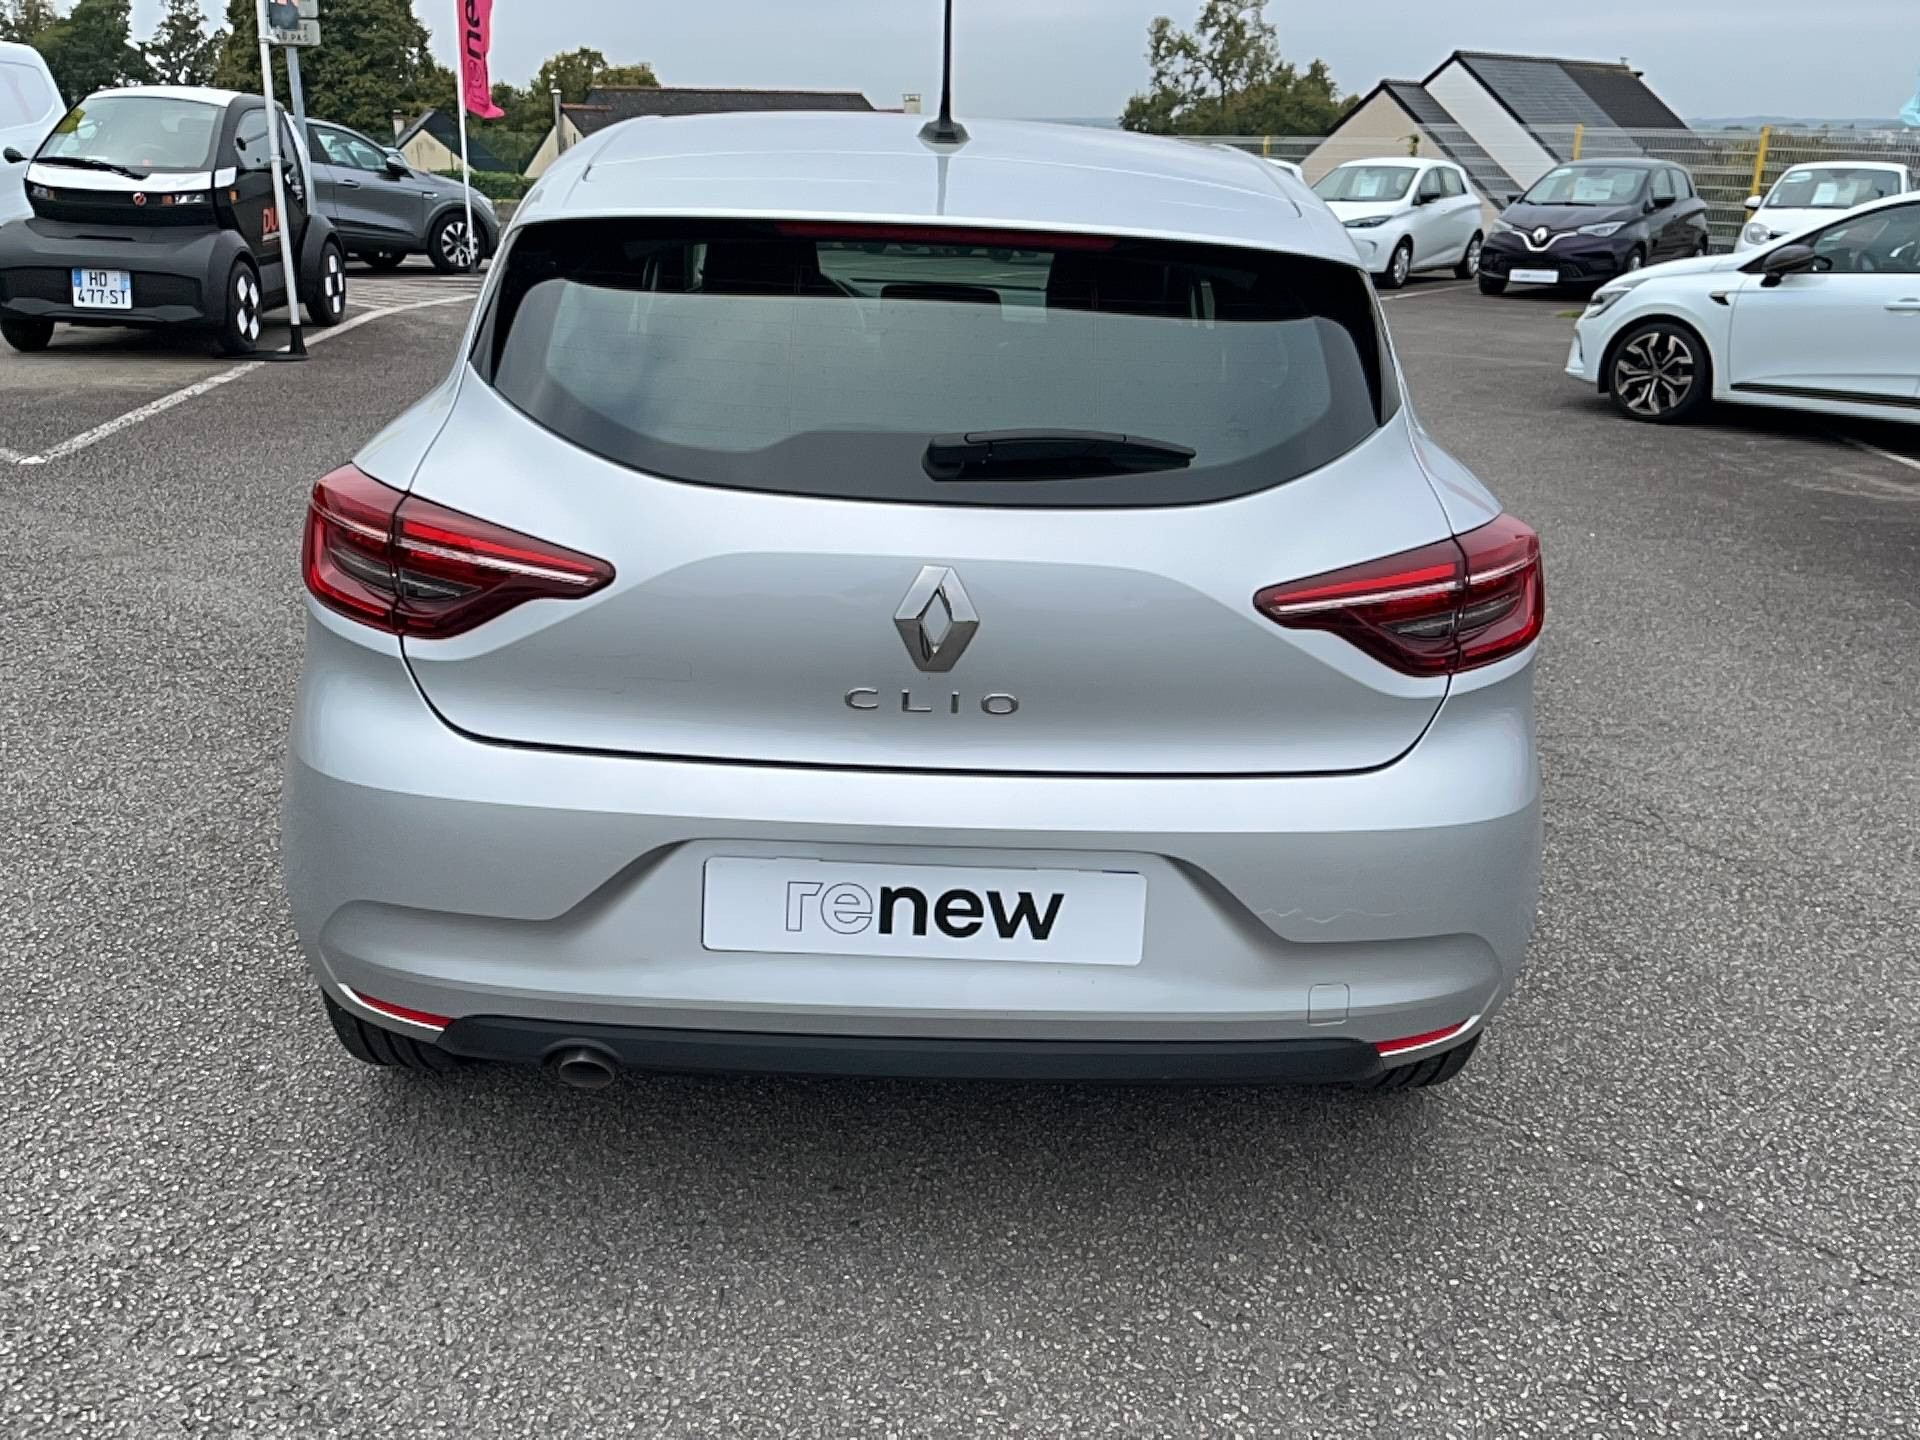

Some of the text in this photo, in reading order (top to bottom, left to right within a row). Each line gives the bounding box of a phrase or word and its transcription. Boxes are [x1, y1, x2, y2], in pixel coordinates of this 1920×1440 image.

[465, 0, 485, 105] rene
[262, 208, 280, 234] DU
[844, 687, 1019, 715] CLIO
[786, 881, 1065, 941] renew
